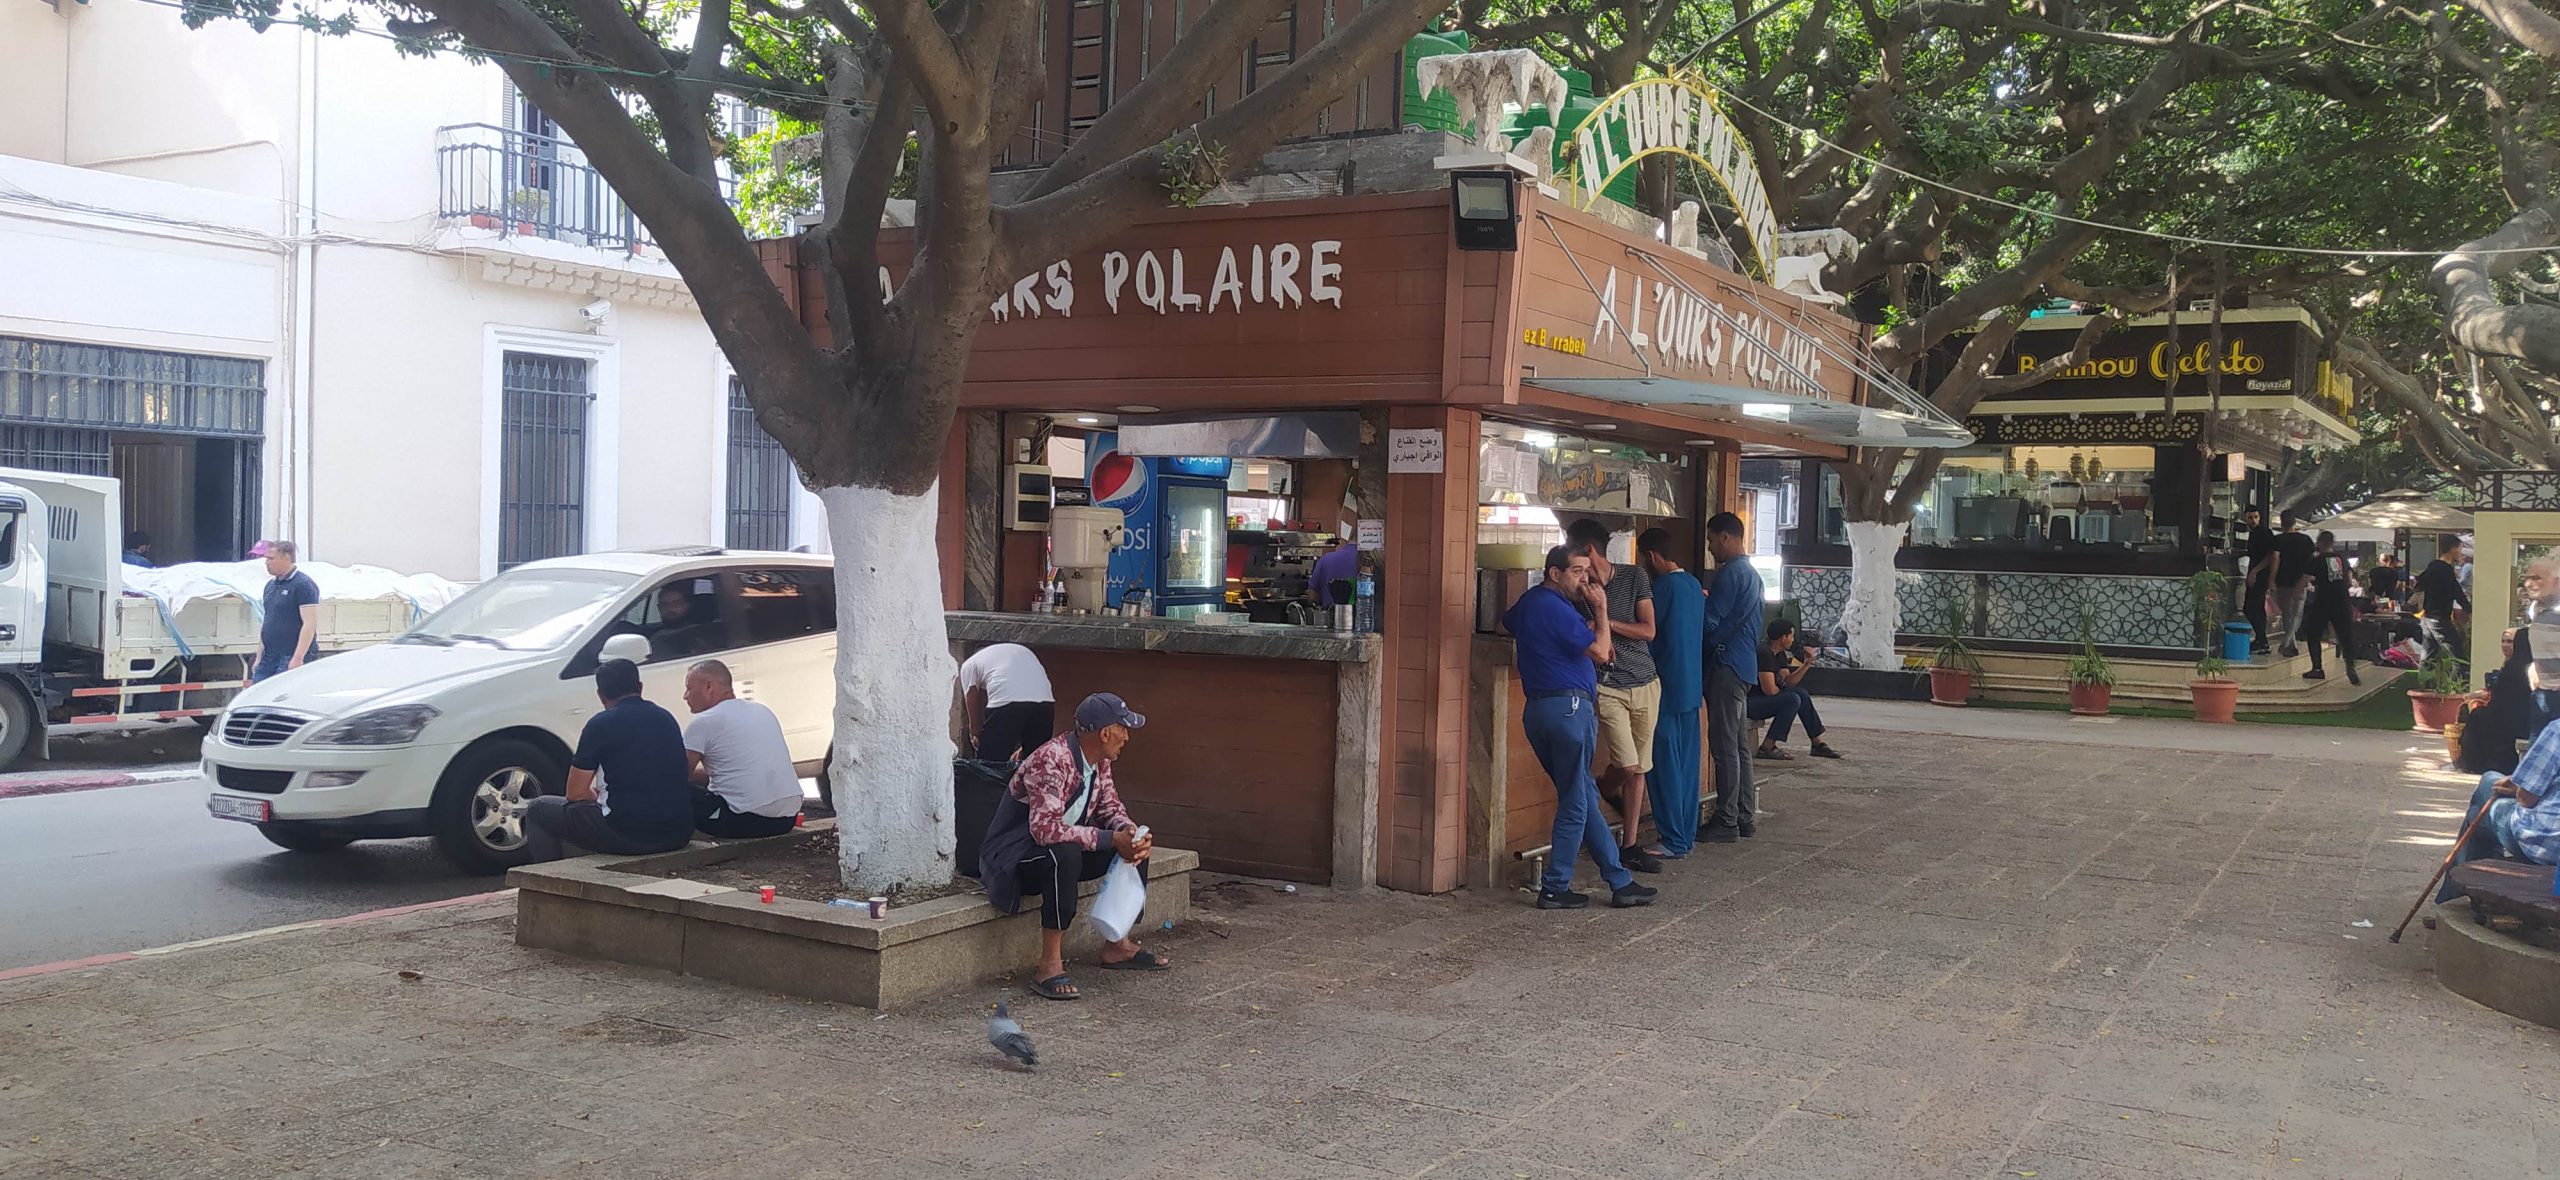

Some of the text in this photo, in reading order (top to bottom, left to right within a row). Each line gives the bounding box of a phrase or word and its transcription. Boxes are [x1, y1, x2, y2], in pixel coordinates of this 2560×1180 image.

[1580, 127, 1602, 201] A
[1698, 95, 1774, 263] POLAIRE
[1102, 240, 1343, 315] POLAIRE
[1593, 265, 1617, 353] A
[1728, 310, 1823, 397] POLAIRE
[1396, 436, 1437, 448] وضع القناع
[1419, 449, 1442, 462] الواقي
[1117, 521, 1150, 556] psi
